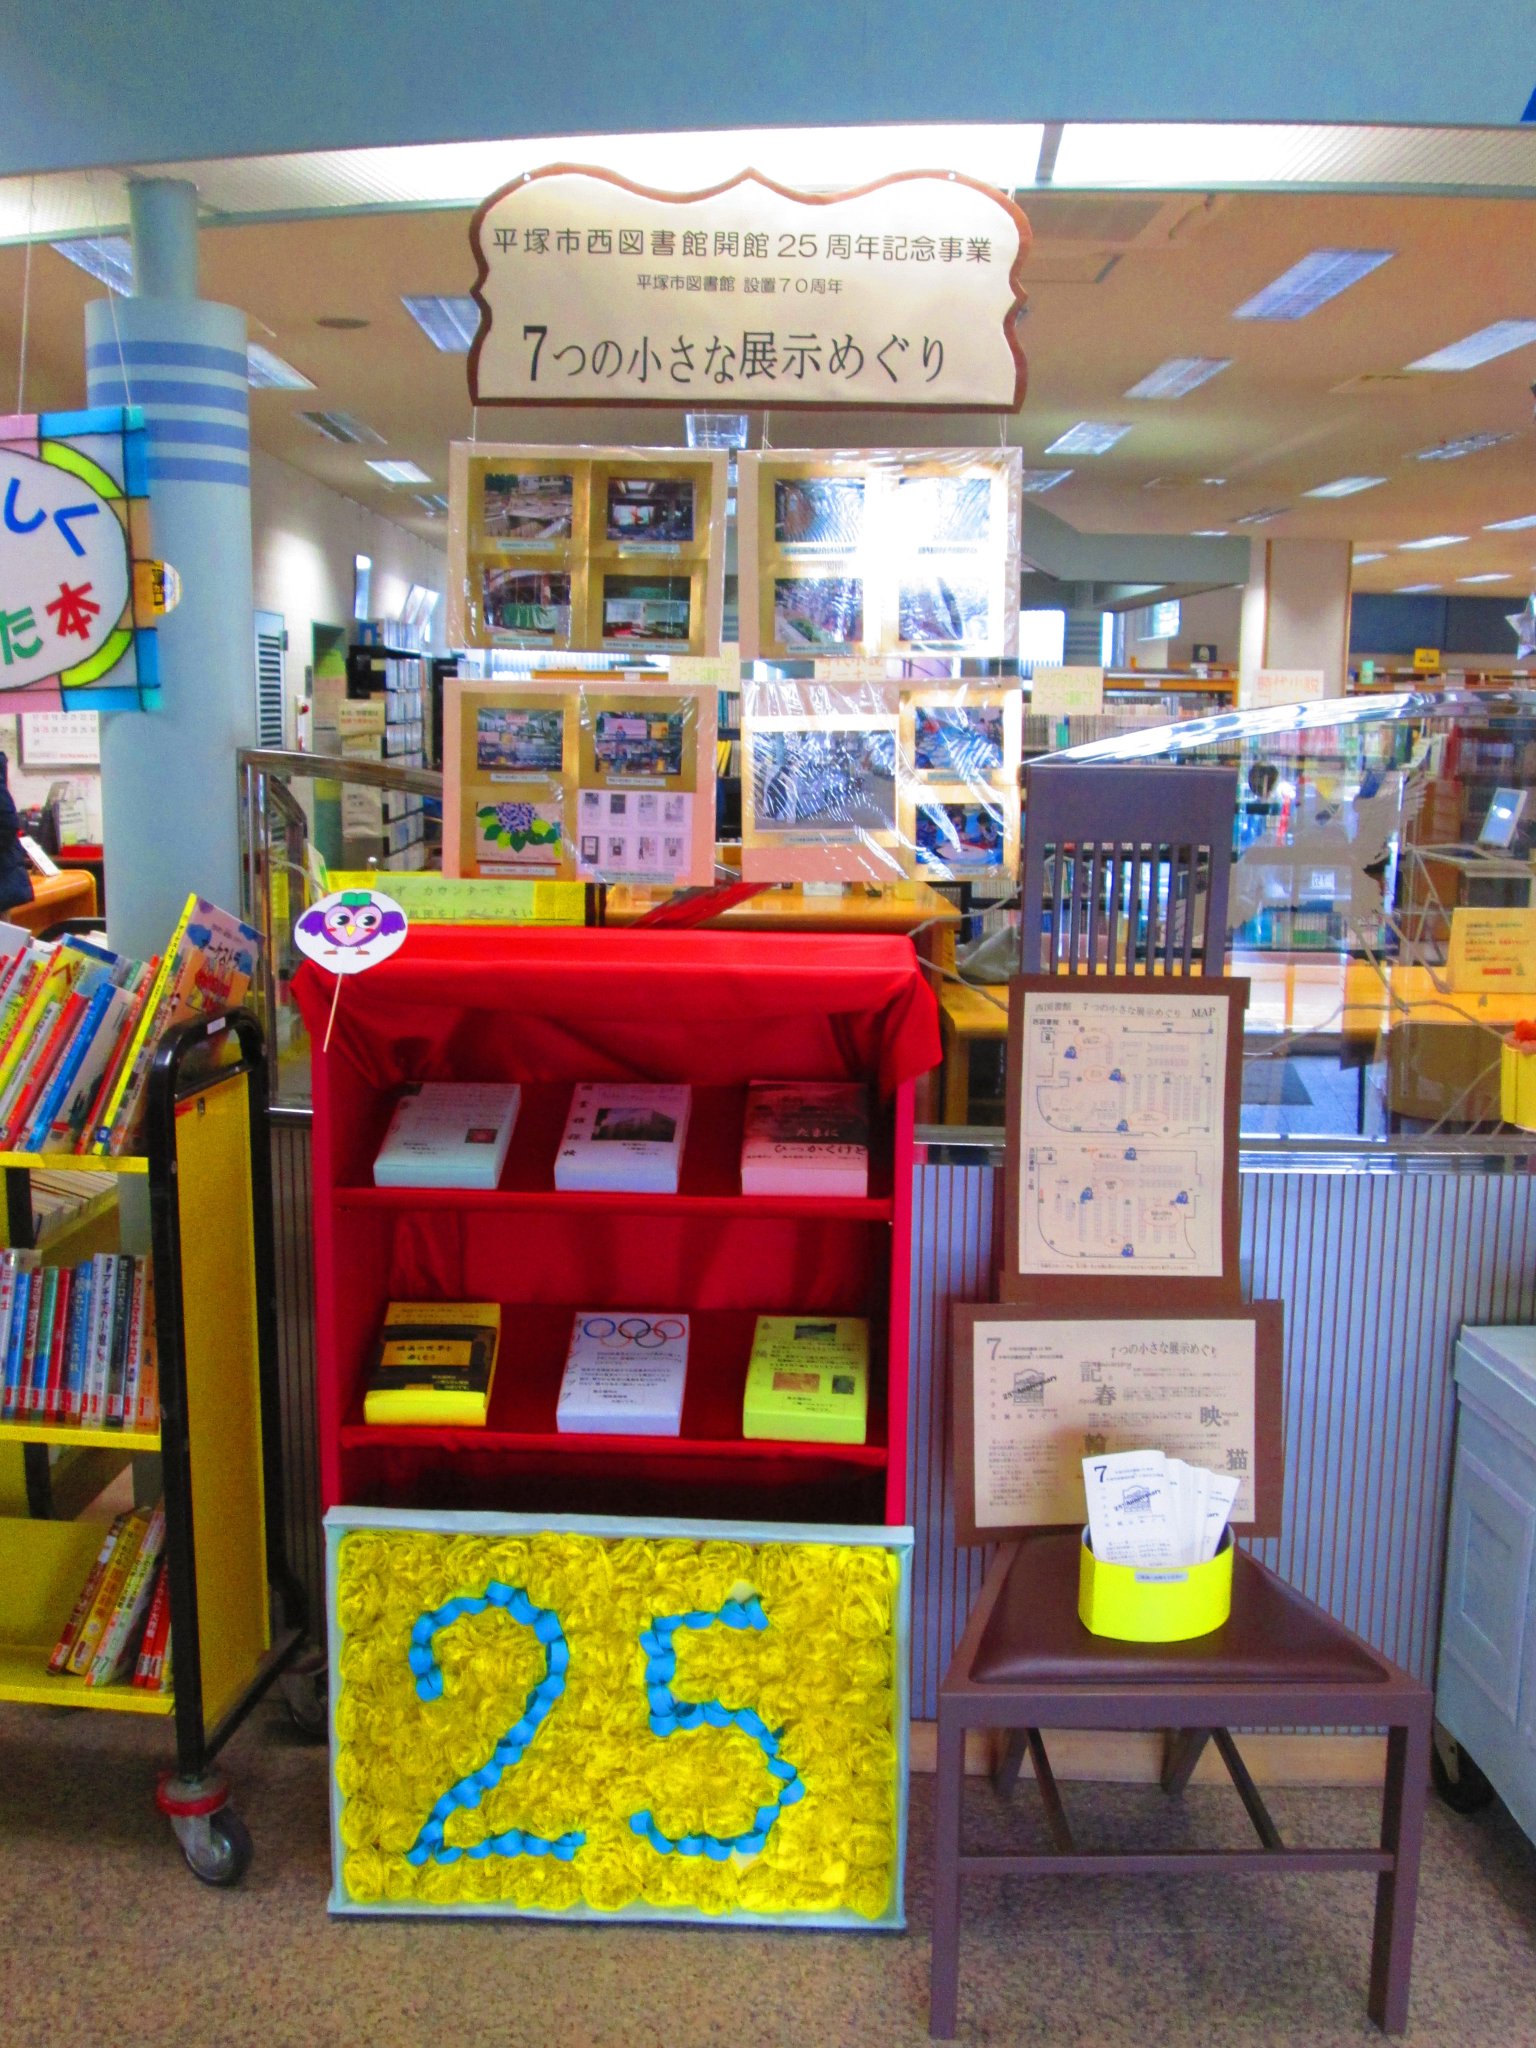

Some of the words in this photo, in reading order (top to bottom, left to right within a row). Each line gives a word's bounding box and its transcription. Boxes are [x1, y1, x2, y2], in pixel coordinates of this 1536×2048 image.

[635, 273, 736, 293] 平塚市図書館
[521, 324, 946, 384] 7つの小さな展示めぐり
[1191, 1007, 1216, 1019] MAP
[986, 1337, 1002, 1361] 7
[1094, 1384, 1118, 1407] 春
[1226, 1448, 1249, 1471] 猫
[1094, 1465, 1108, 1484] 7
[407, 1579, 807, 1868] 25
